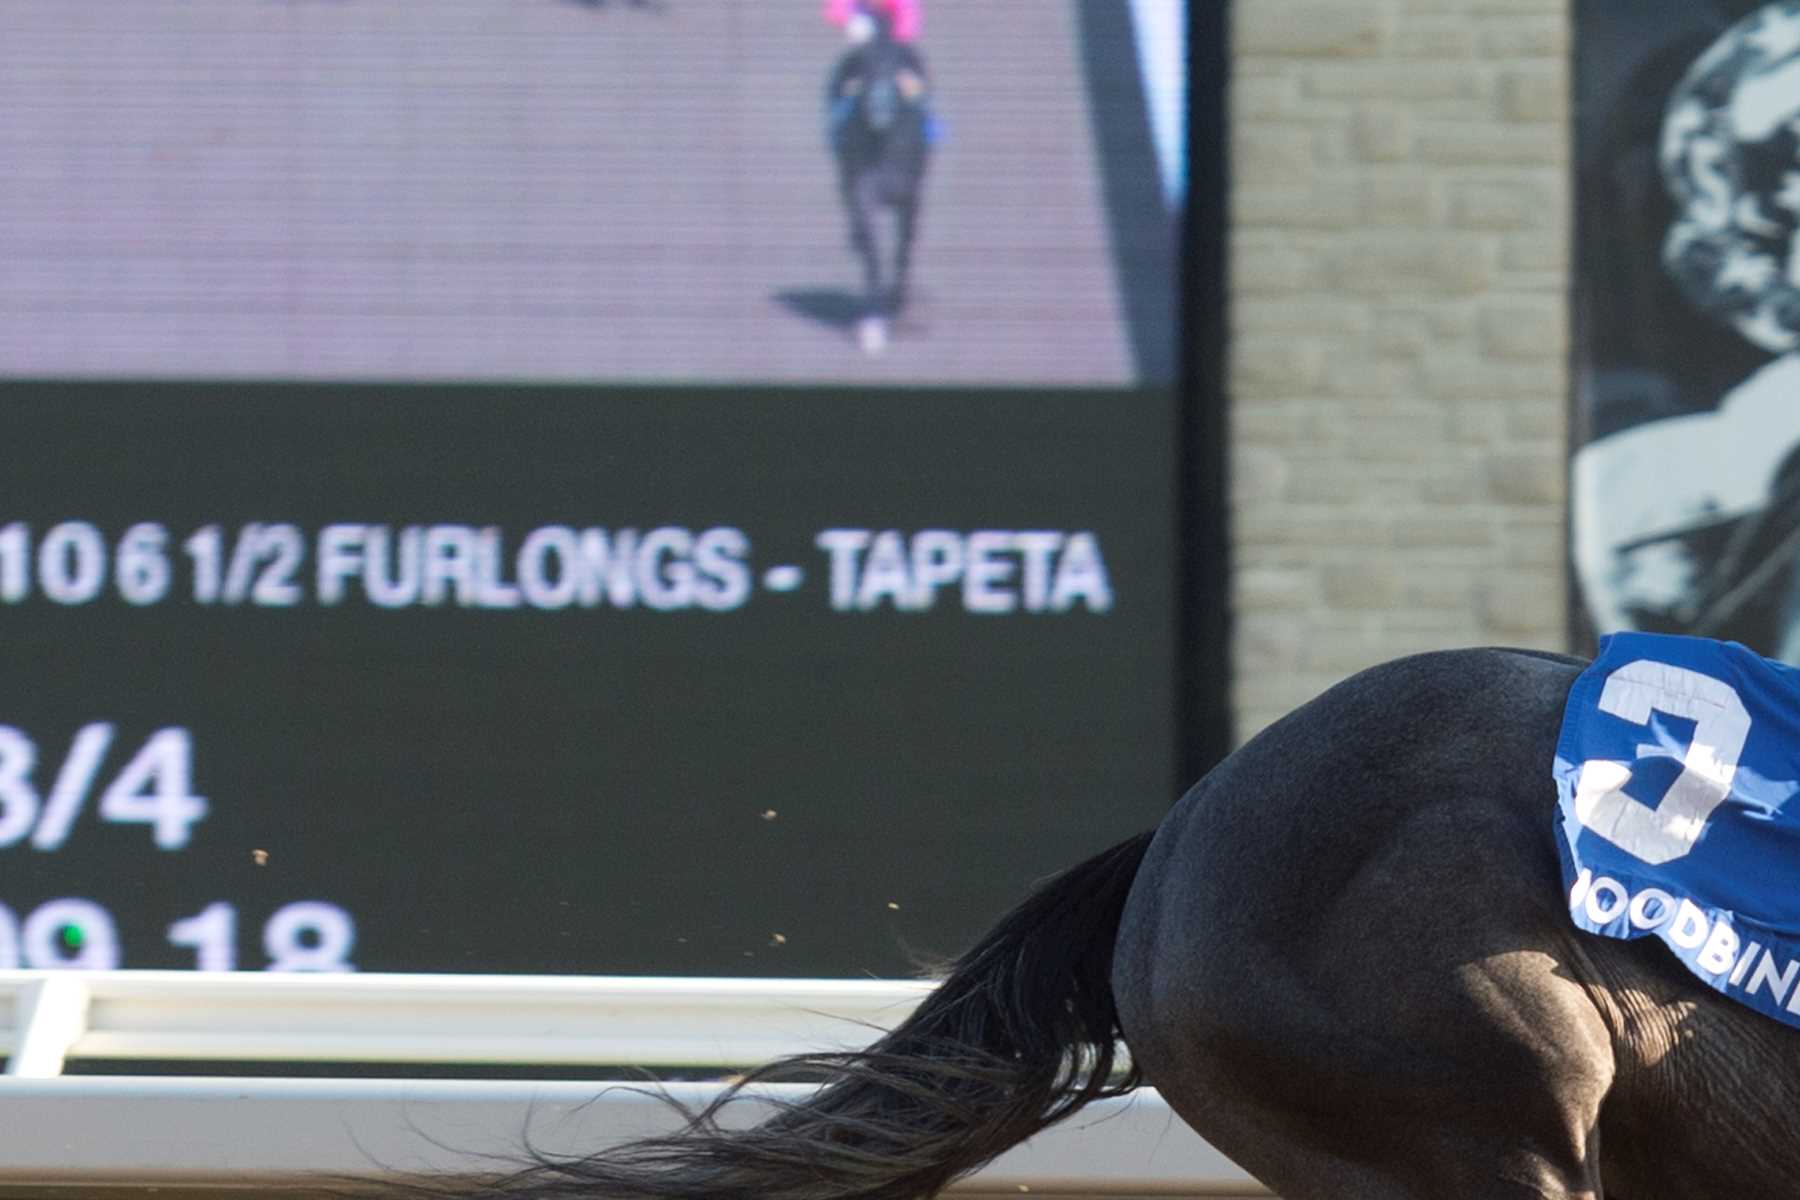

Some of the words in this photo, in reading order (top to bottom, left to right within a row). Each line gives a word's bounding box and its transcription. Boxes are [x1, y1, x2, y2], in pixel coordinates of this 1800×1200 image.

[182, 522, 305, 606] 1/2
[317, 524, 753, 611] FURLONGS
[817, 530, 1114, 613] TAPETA
